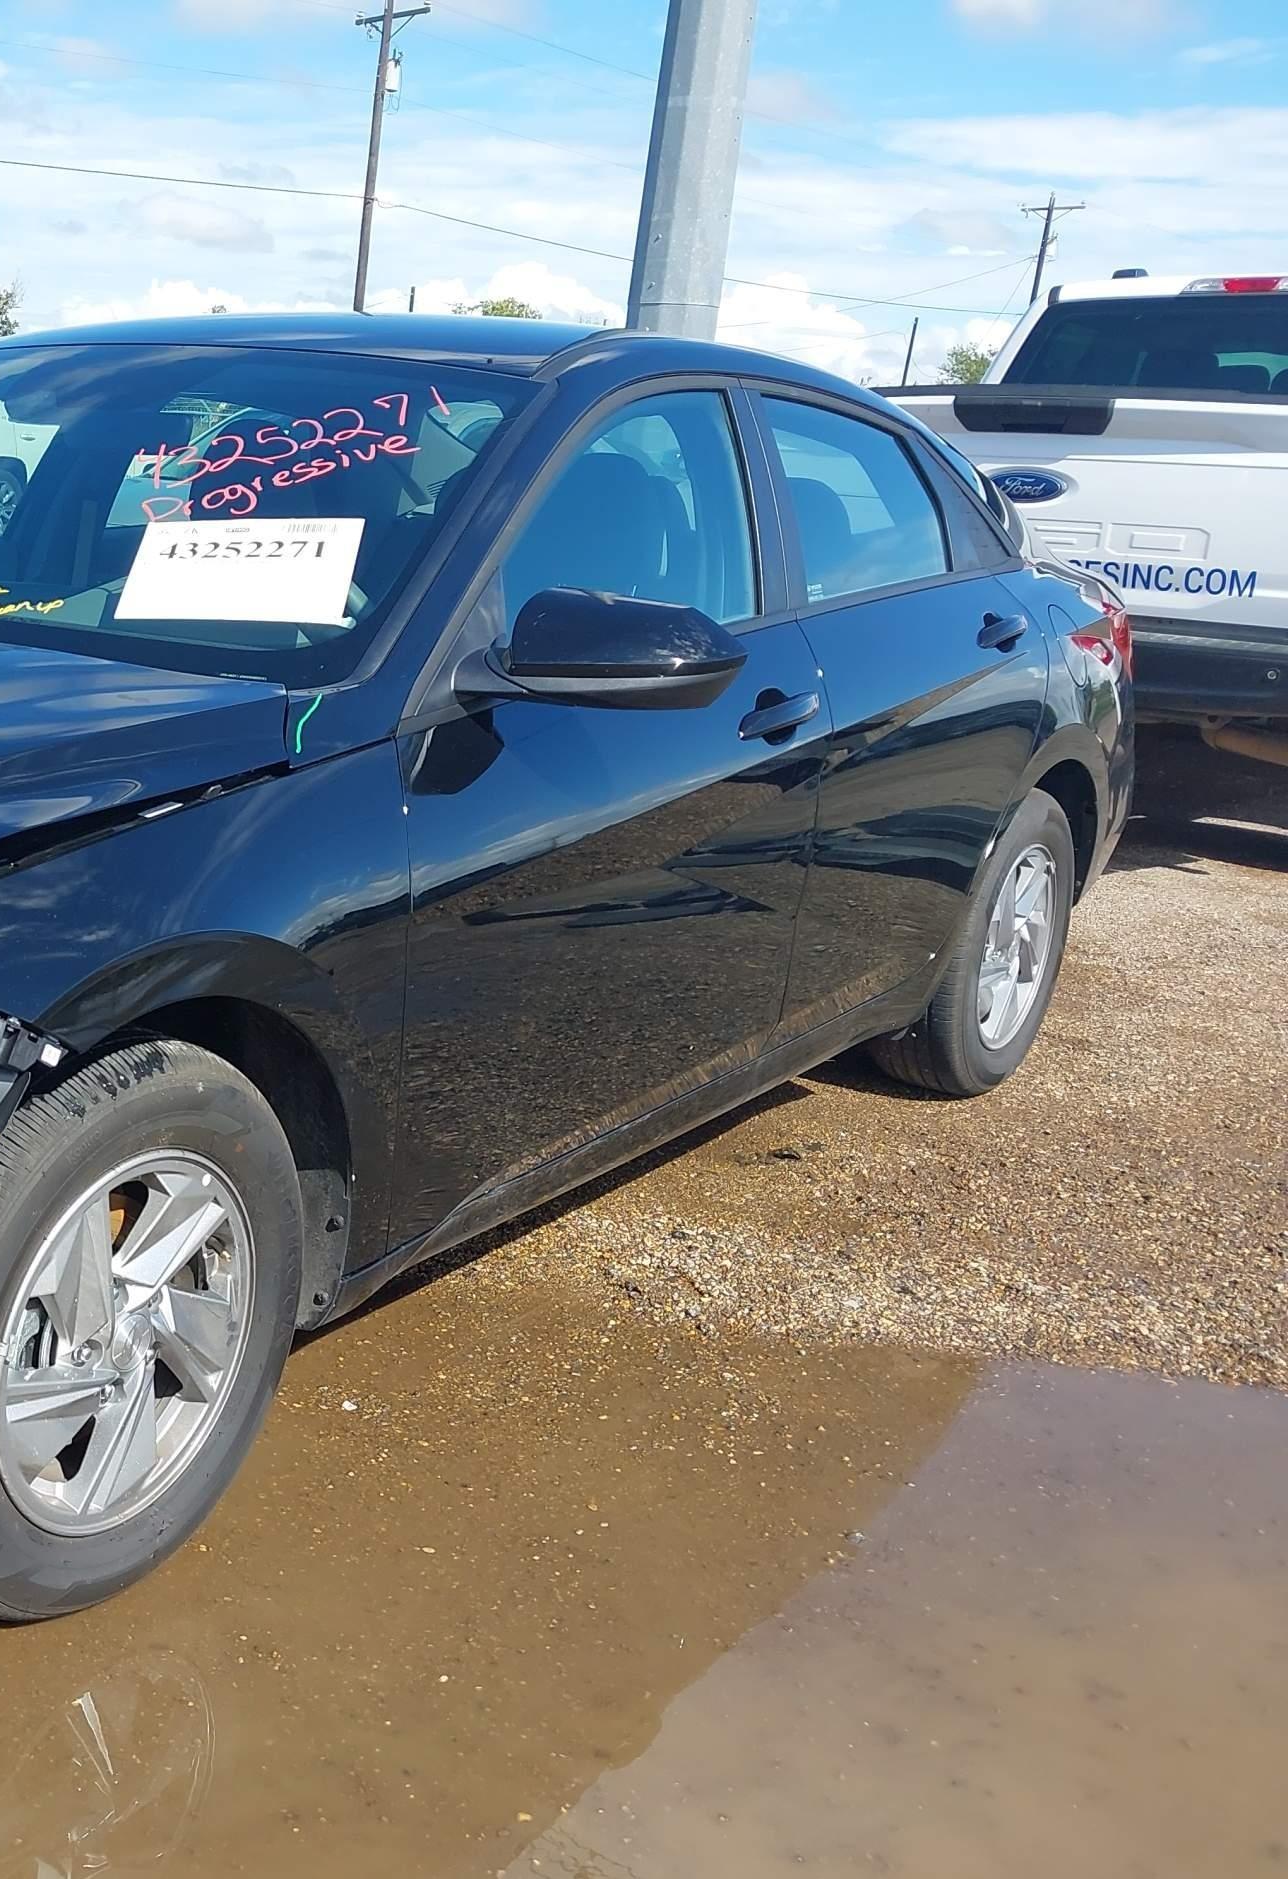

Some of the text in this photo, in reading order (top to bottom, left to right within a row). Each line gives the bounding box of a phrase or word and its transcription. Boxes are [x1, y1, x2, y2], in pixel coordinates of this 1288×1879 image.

[138, 386, 450, 489] 43252271
[999, 476, 1046, 497] Ford
[159, 541, 325, 560] 43252271
[1068, 559, 1258, 598] SINC.COM
